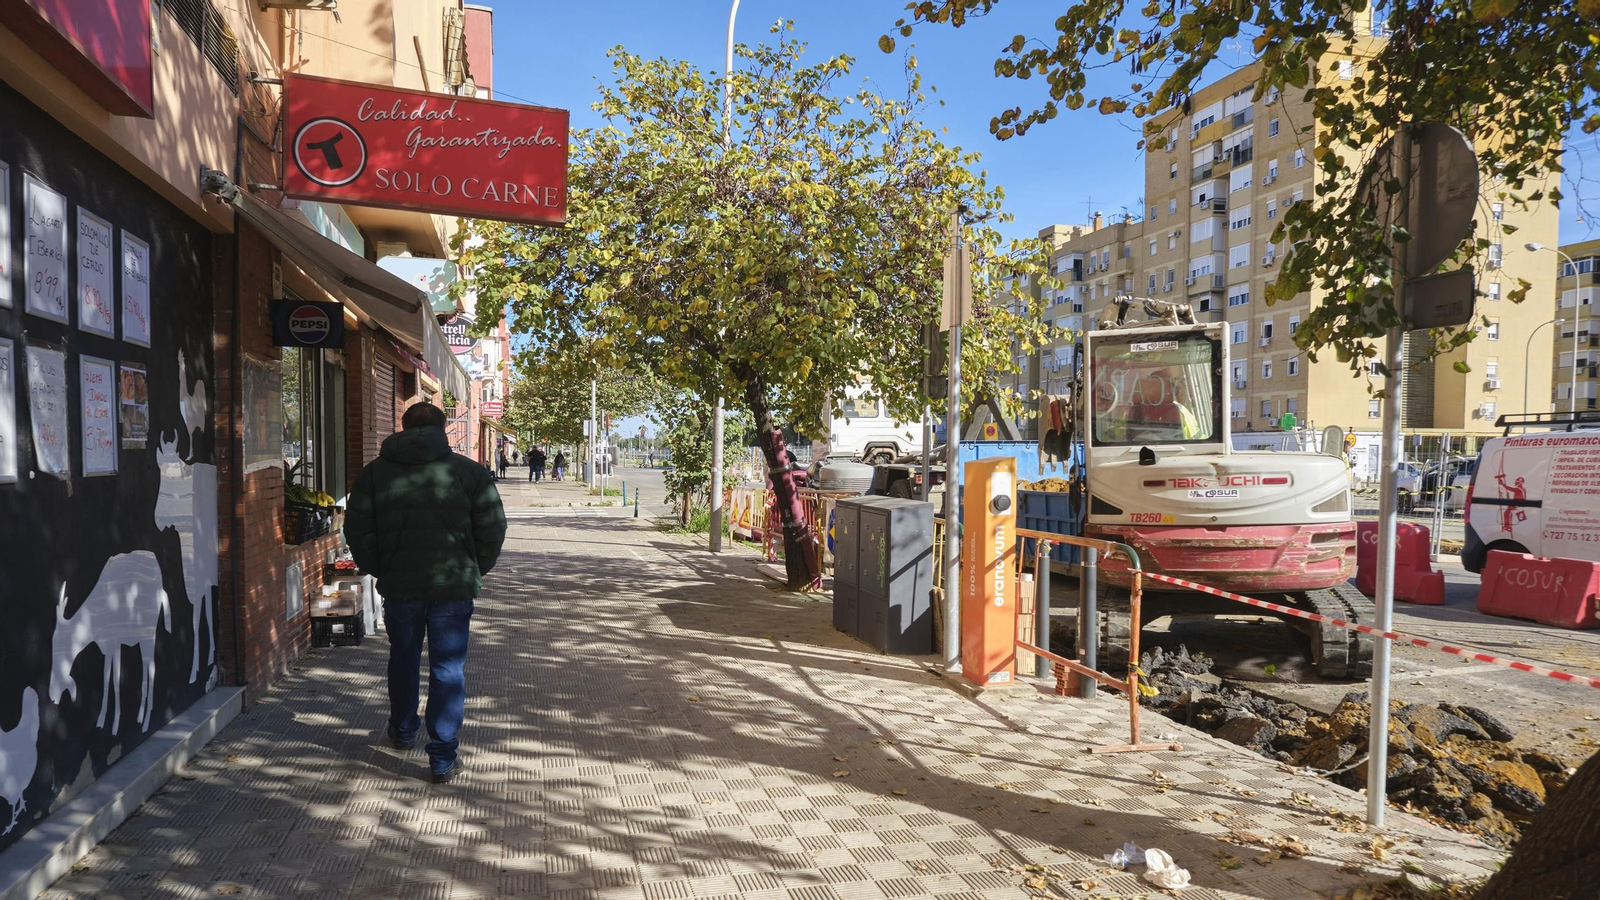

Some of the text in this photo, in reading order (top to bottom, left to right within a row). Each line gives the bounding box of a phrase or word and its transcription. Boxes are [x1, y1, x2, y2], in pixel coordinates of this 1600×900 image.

[375, 168, 560, 208] SOLO CARNE
[89, 242, 99, 255] DE
[82, 255, 104, 275] CERDO
[291, 319, 328, 329] PEPSI
[1504, 436, 1544, 447] Pinturas
[1168, 475, 1260, 488] TAKUCHI
[1205, 489, 1238, 498] COSUR
[1130, 512, 1162, 523] TB260
[1550, 531, 1565, 540] 727
[1567, 532, 1578, 541] 75
[1581, 533, 1591, 542] 12
[993, 525, 1005, 607] eranovum
